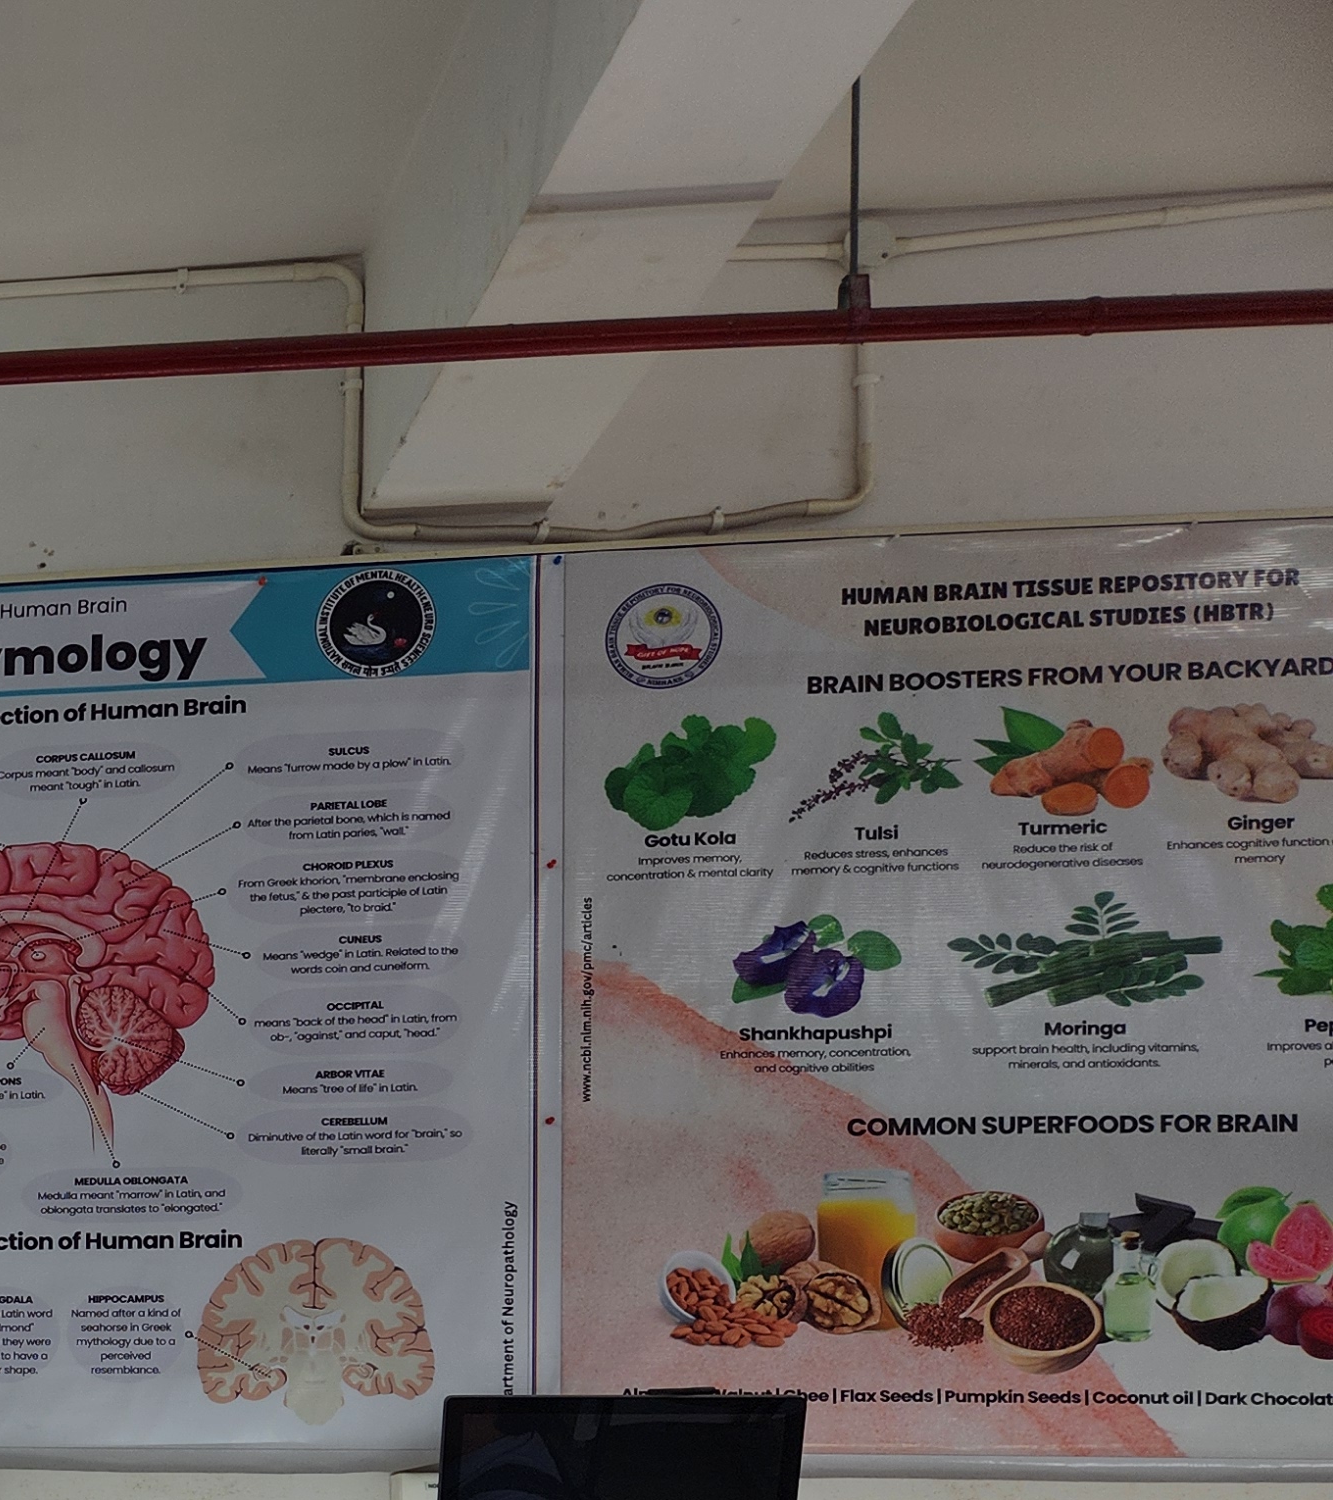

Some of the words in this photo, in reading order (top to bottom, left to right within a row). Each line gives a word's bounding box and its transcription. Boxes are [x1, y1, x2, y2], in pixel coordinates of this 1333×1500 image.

[841, 584, 928, 606] HUMAN
[933, 581, 1008, 602] BRAIN
[1012, 577, 1094, 599] TISSUE
[1098, 570, 1249, 595] REPOSITORY
[1253, 567, 1300, 588] FOR
[0, 602, 72, 619] Human
[77, 596, 127, 615] Brain
[864, 610, 1085, 637] NEUROBIOLOGICAL
[1088, 605, 1187, 628] STUDIES
[1193, 602, 1274, 625] (HBTR)
[807, 673, 884, 695] BRAIN
[889, 668, 1023, 692] BOOSTERS
[1028, 665, 1103, 687] FROM
[1107, 662, 1182, 683] YOUR
[1187, 656, 1333, 681] BACKYARD
[63, 702, 87, 723] of
[90, 702, 179, 721] Human
[183, 694, 247, 717] Brain
[35, 753, 79, 764] CORPUS
[79, 750, 136, 762] CALLOSUM
[328, 745, 370, 757] SULCUS
[310, 800, 360, 811] PARIETAL
[360, 798, 388, 809] LOBE
[854, 824, 899, 841] Tulsi
[1017, 818, 1108, 836] Turmeric
[1227, 814, 1296, 834] Ginger
[644, 833, 691, 848] Gotu
[694, 830, 737, 846] Kola
[803, 849, 853, 861] Reduces
[892, 847, 949, 858] enhances
[1091, 857, 1144, 868] diseases
[338, 934, 383, 945] CUNEUS
[326, 1000, 385, 1012] OCCIPITAL
[739, 1023, 893, 1045] Shankhapushpi
[1044, 1019, 1127, 1040] Moringa
[314, 1069, 353, 1080] ARBOR
[354, 1069, 385, 1079] VITAE
[320, 1116, 388, 1127] CEREBELLUM
[846, 1116, 976, 1137] COMMON
[981, 1114, 1155, 1135] SUPERFOODS
[1160, 1114, 1212, 1133] FOR
[1216, 1113, 1298, 1133] BRAIN
[74, 1177, 122, 1186] MEDULLA
[122, 1175, 189, 1185] OBLONGATA
[57, 1230, 82, 1250] of
[85, 1232, 174, 1250] Human
[179, 1228, 243, 1249] Brain
[501, 1201, 518, 1316] Neuropathology
[87, 1294, 165, 1304] HIPPOCAMPUS
[501, 1319, 514, 1335] of
[501, 1338, 514, 1396] artment
[840, 1388, 874, 1404] Flax
[879, 1388, 933, 1404] Seeds
[944, 1388, 1024, 1408] Pumpkin
[1027, 1390, 1081, 1406] Seeds
[1093, 1390, 1167, 1406] Coconut
[1172, 1390, 1193, 1406] oil
[1205, 1390, 1247, 1406] Dark
[1251, 1390, 1333, 1407] Chocolat
